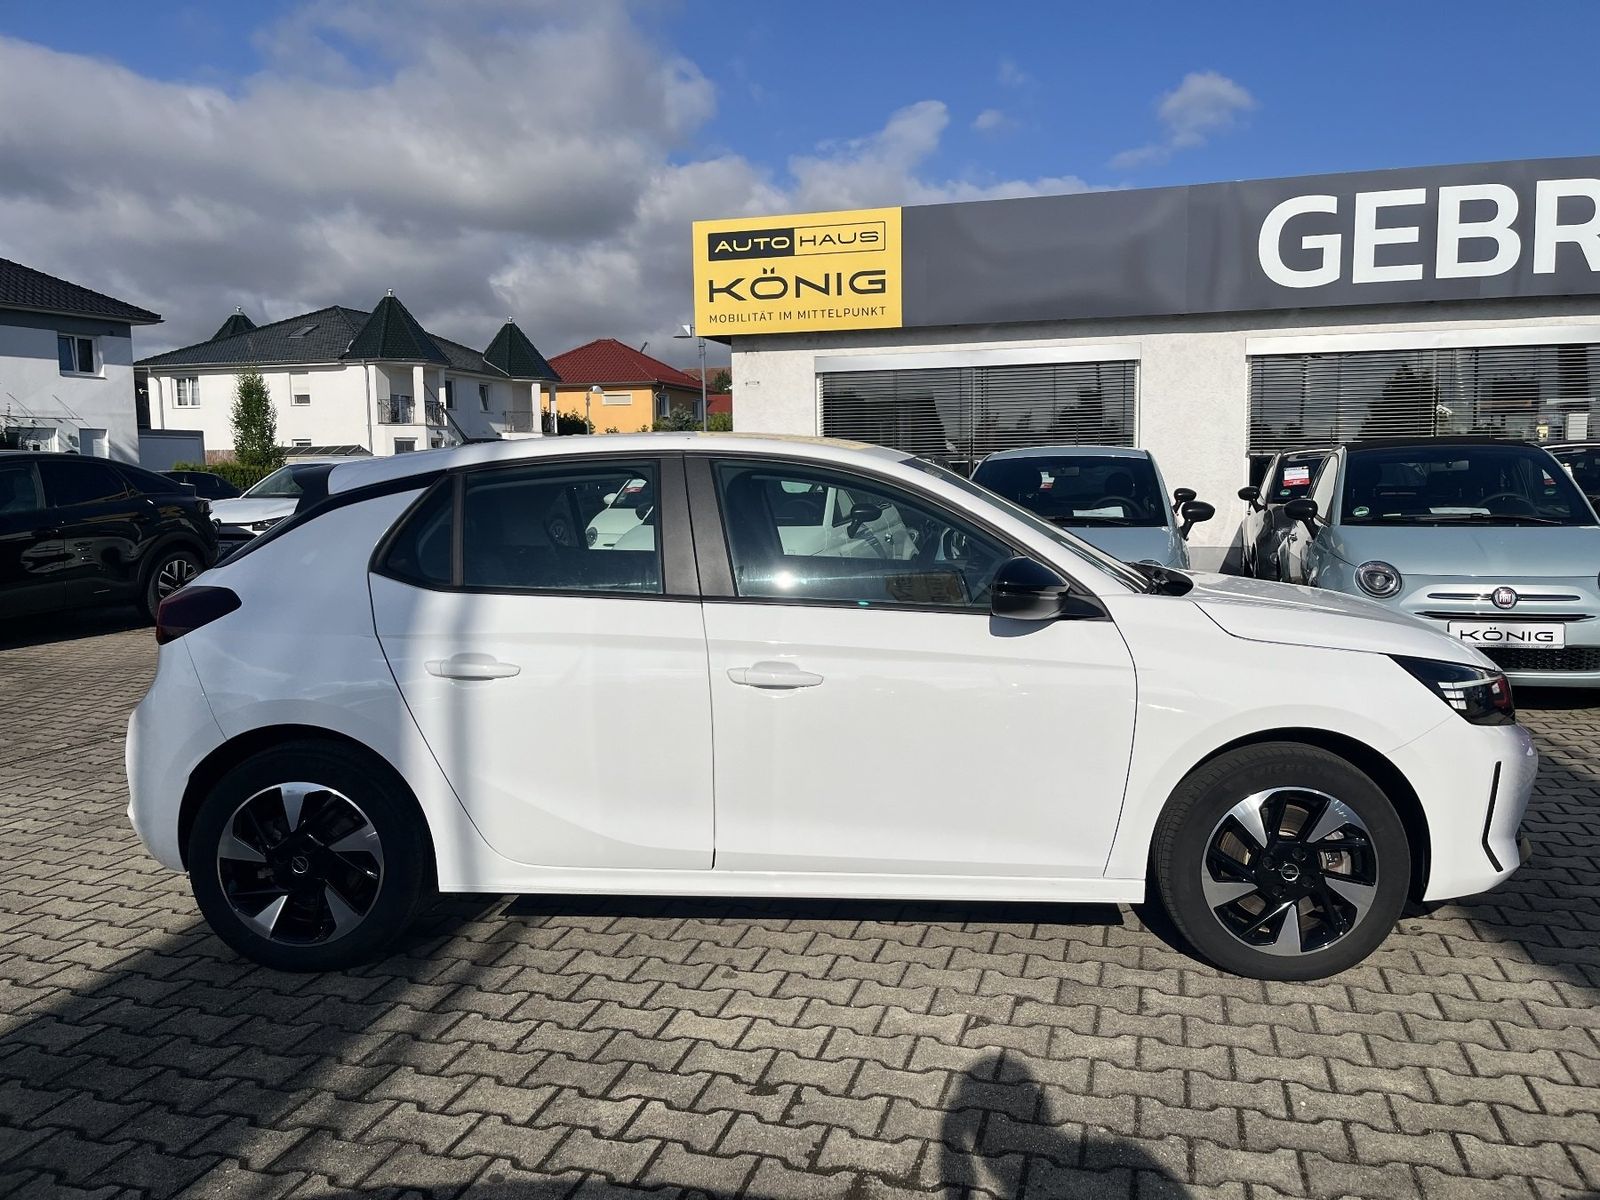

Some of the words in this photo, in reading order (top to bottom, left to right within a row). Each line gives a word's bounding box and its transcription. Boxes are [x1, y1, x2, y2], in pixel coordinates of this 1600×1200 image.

[715, 236, 790, 253] AUTO
[800, 231, 879, 247] HAUS
[1258, 178, 1600, 288] GEBR
[708, 266, 886, 303] KÖNIG
[710, 310, 774, 323] MOBILITÄT
[779, 311, 792, 320] IM
[797, 306, 887, 320] MITTELPUNKT
[1499, 591, 1512, 603] FIAT
[1460, 626, 1554, 642] KÖNIG
